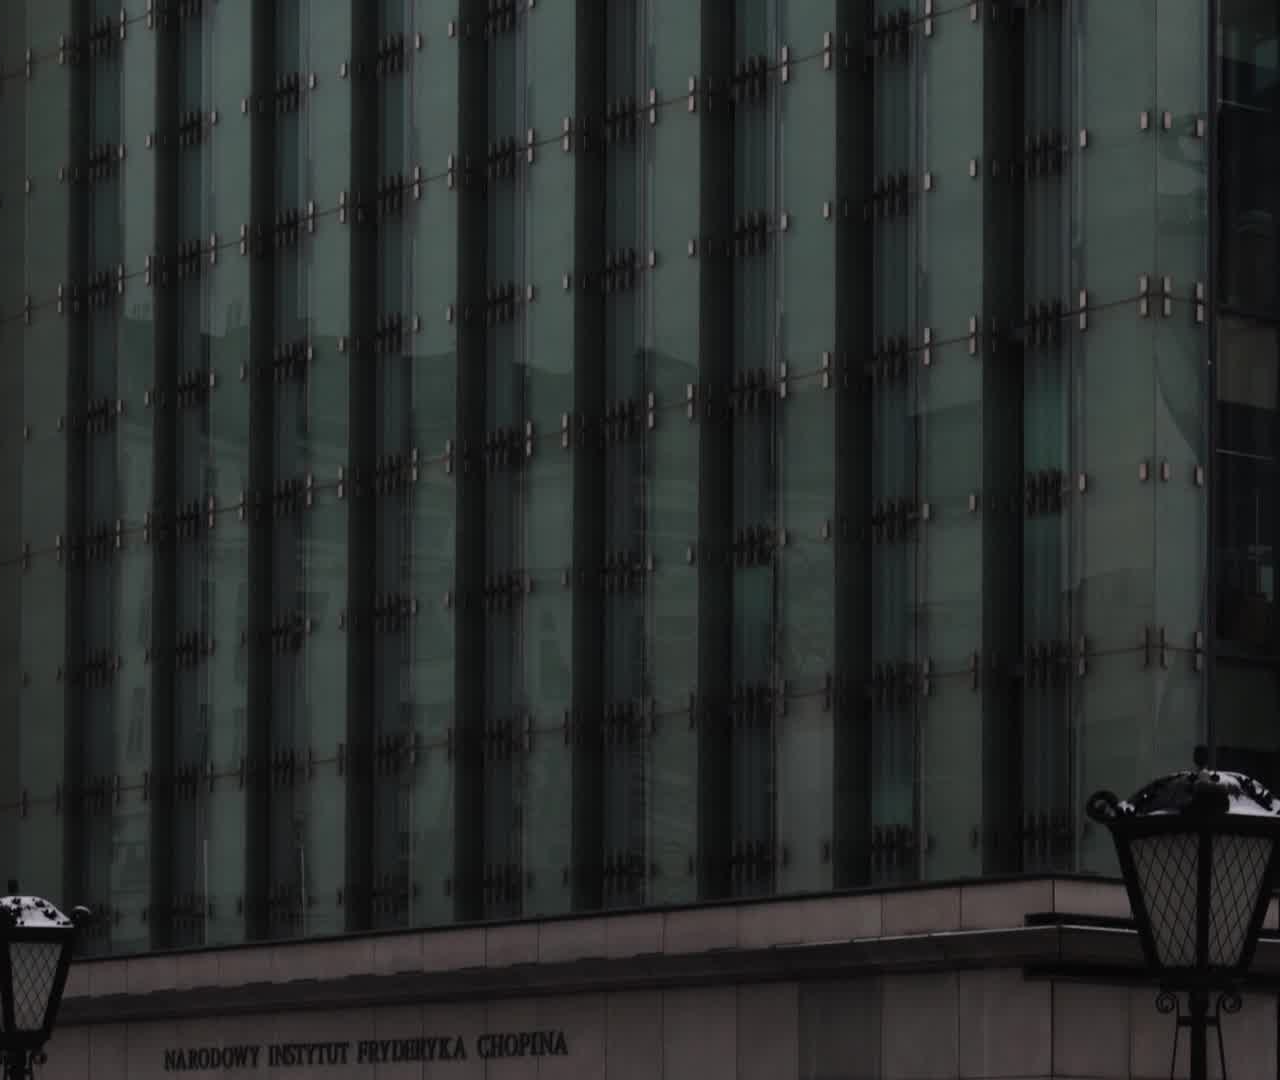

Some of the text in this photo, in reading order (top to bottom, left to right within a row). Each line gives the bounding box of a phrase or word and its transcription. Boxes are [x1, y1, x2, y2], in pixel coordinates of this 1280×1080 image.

[163, 1044, 261, 1071] NARODOWY
[269, 1040, 349, 1067] INSTYTUT
[477, 1030, 569, 1058] CHOPINA
